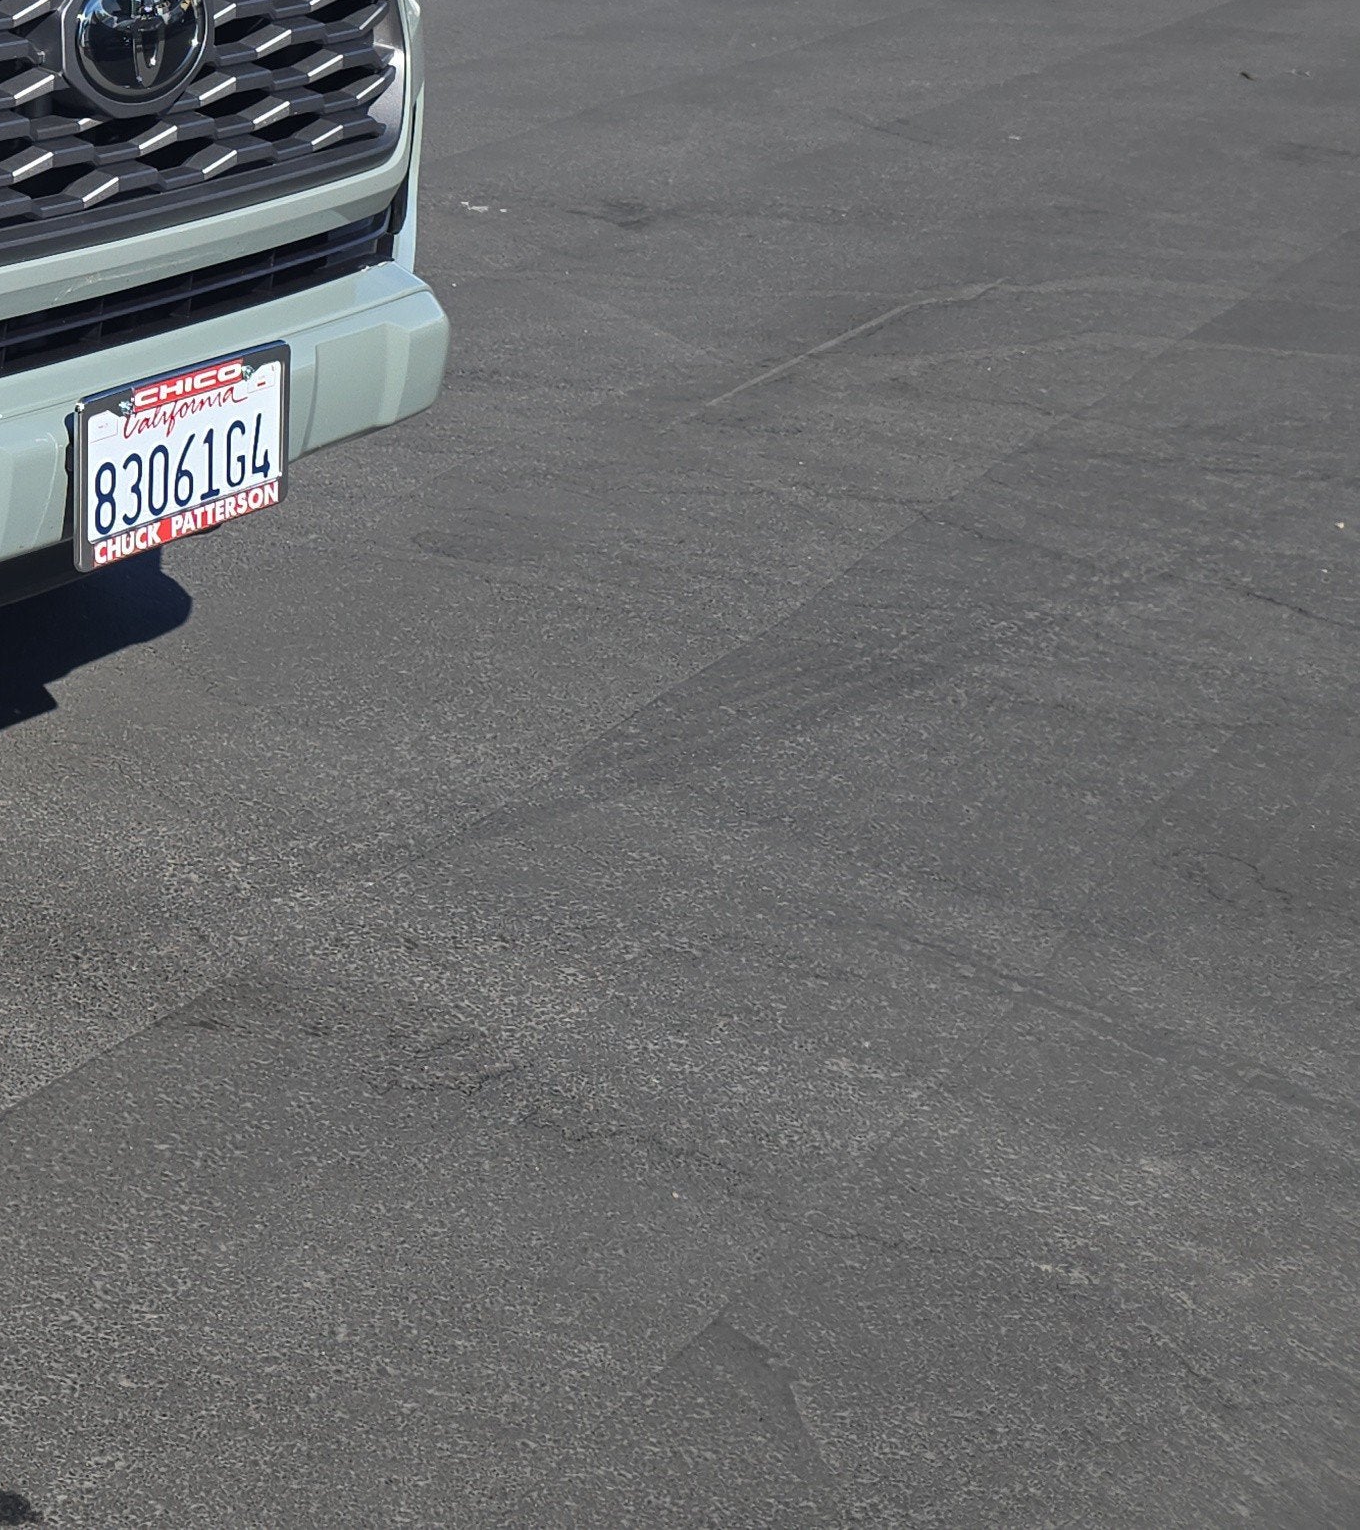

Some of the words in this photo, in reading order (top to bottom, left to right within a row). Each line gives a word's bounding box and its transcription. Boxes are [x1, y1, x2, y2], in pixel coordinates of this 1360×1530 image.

[123, 386, 248, 439] California
[134, 362, 243, 407] CHICO
[94, 412, 271, 535] 83061G4
[93, 521, 162, 565] CHUCK
[170, 480, 279, 538] PATTERSON
